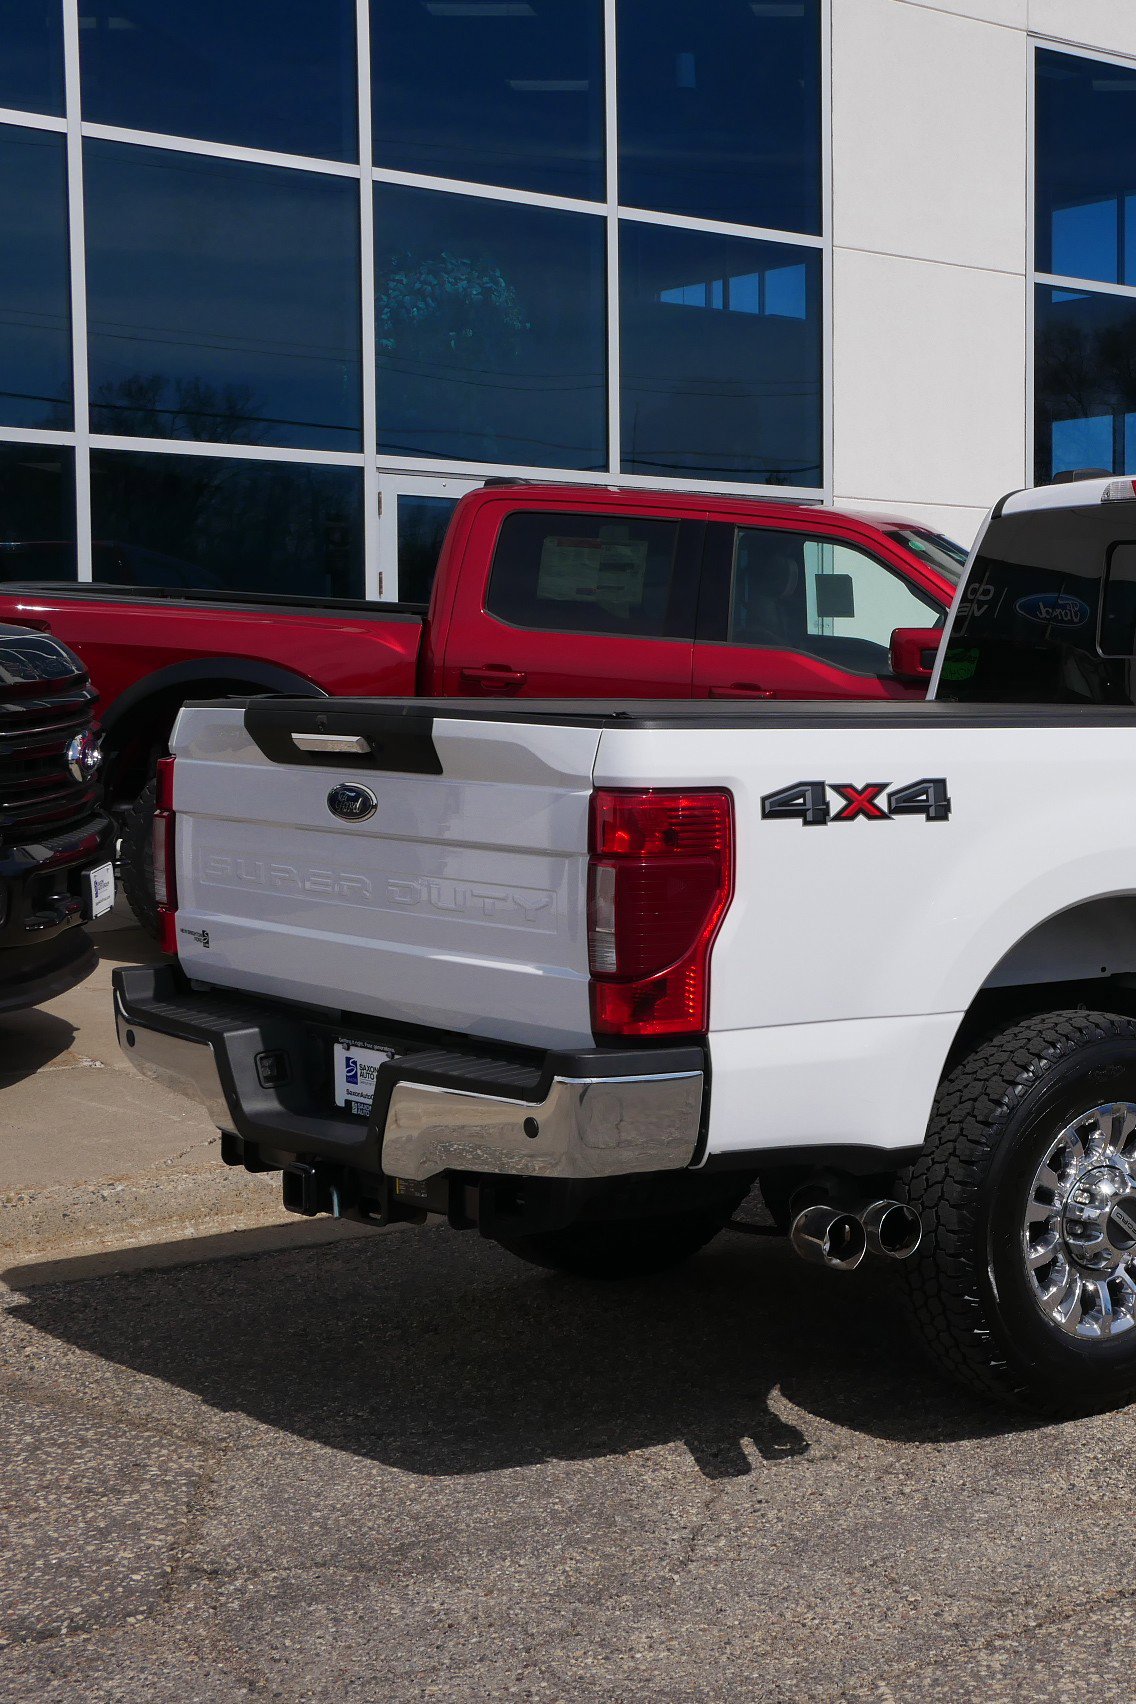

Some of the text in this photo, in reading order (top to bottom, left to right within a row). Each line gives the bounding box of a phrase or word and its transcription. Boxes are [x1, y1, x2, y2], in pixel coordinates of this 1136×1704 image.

[205, 855, 554, 922] SUPER DUTY
[359, 1064, 379, 1074] SAXON
[359, 1071, 375, 1081] AUTO
